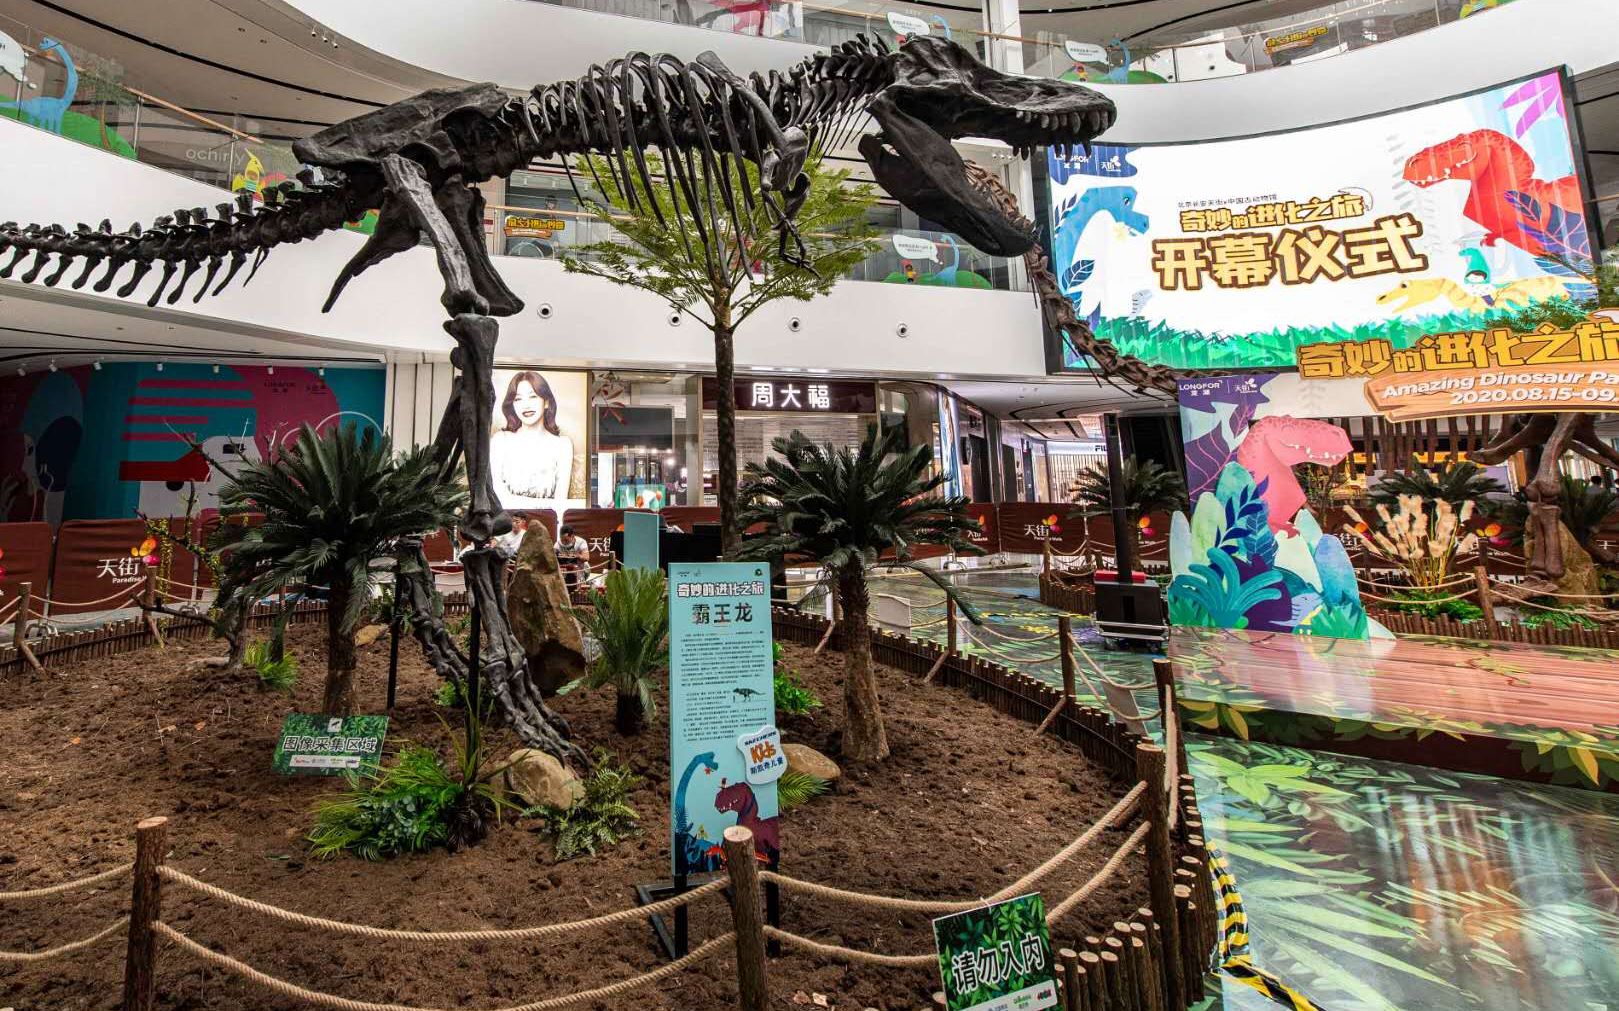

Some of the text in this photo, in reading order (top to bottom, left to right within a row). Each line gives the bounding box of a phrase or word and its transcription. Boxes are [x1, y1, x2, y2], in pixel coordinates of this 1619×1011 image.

[1180, 194, 1365, 233] 奇妙的进化之旅
[1151, 212, 1429, 290] 开幕仪式
[751, 382, 831, 409] 周大福
[1382, 376, 1475, 398] Amazing
[1480, 371, 1585, 388] Dinosaur
[1024, 524, 1050, 537] 天街
[96, 556, 141, 579] 天街
[677, 580, 765, 598] 奇妙的进化之旅
[692, 602, 753, 624] 霸王龙
[283, 736, 378, 753] 图像采集区域
[750, 740, 777, 764] Kids
[951, 932, 1045, 995] 请勿入内
